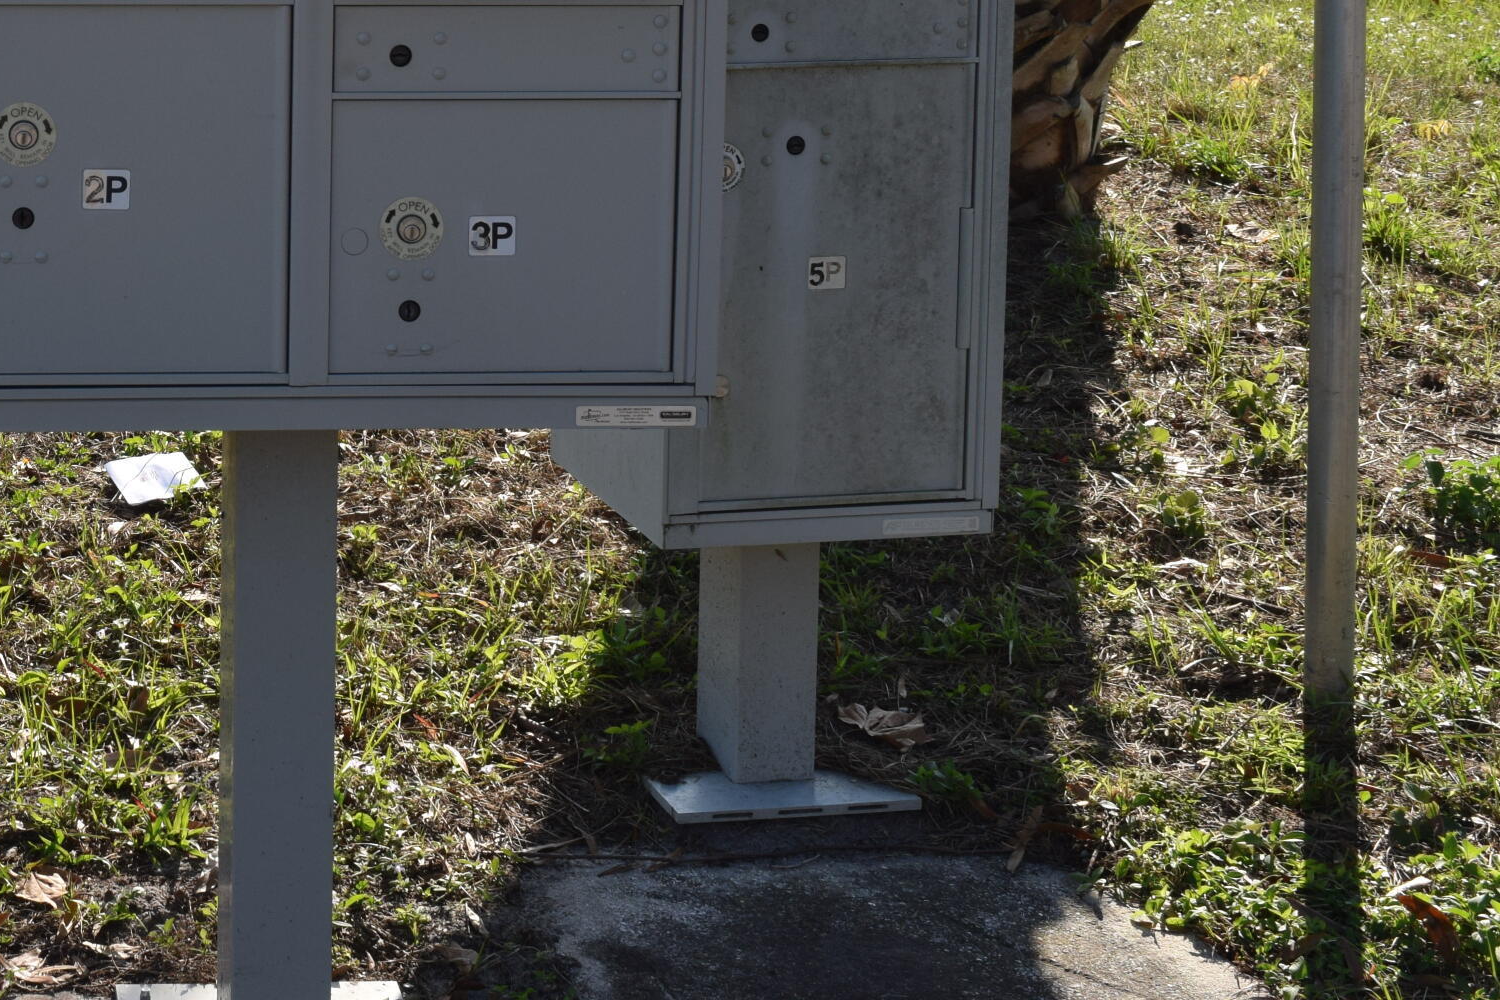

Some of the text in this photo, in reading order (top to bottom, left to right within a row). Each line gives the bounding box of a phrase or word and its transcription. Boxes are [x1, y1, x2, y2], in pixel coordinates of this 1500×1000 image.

[11, 106, 43, 121] OPEN
[85, 175, 128, 203] 2P
[398, 201, 430, 214] OPEN
[471, 221, 513, 250] 3P
[809, 261, 842, 287] 5P
